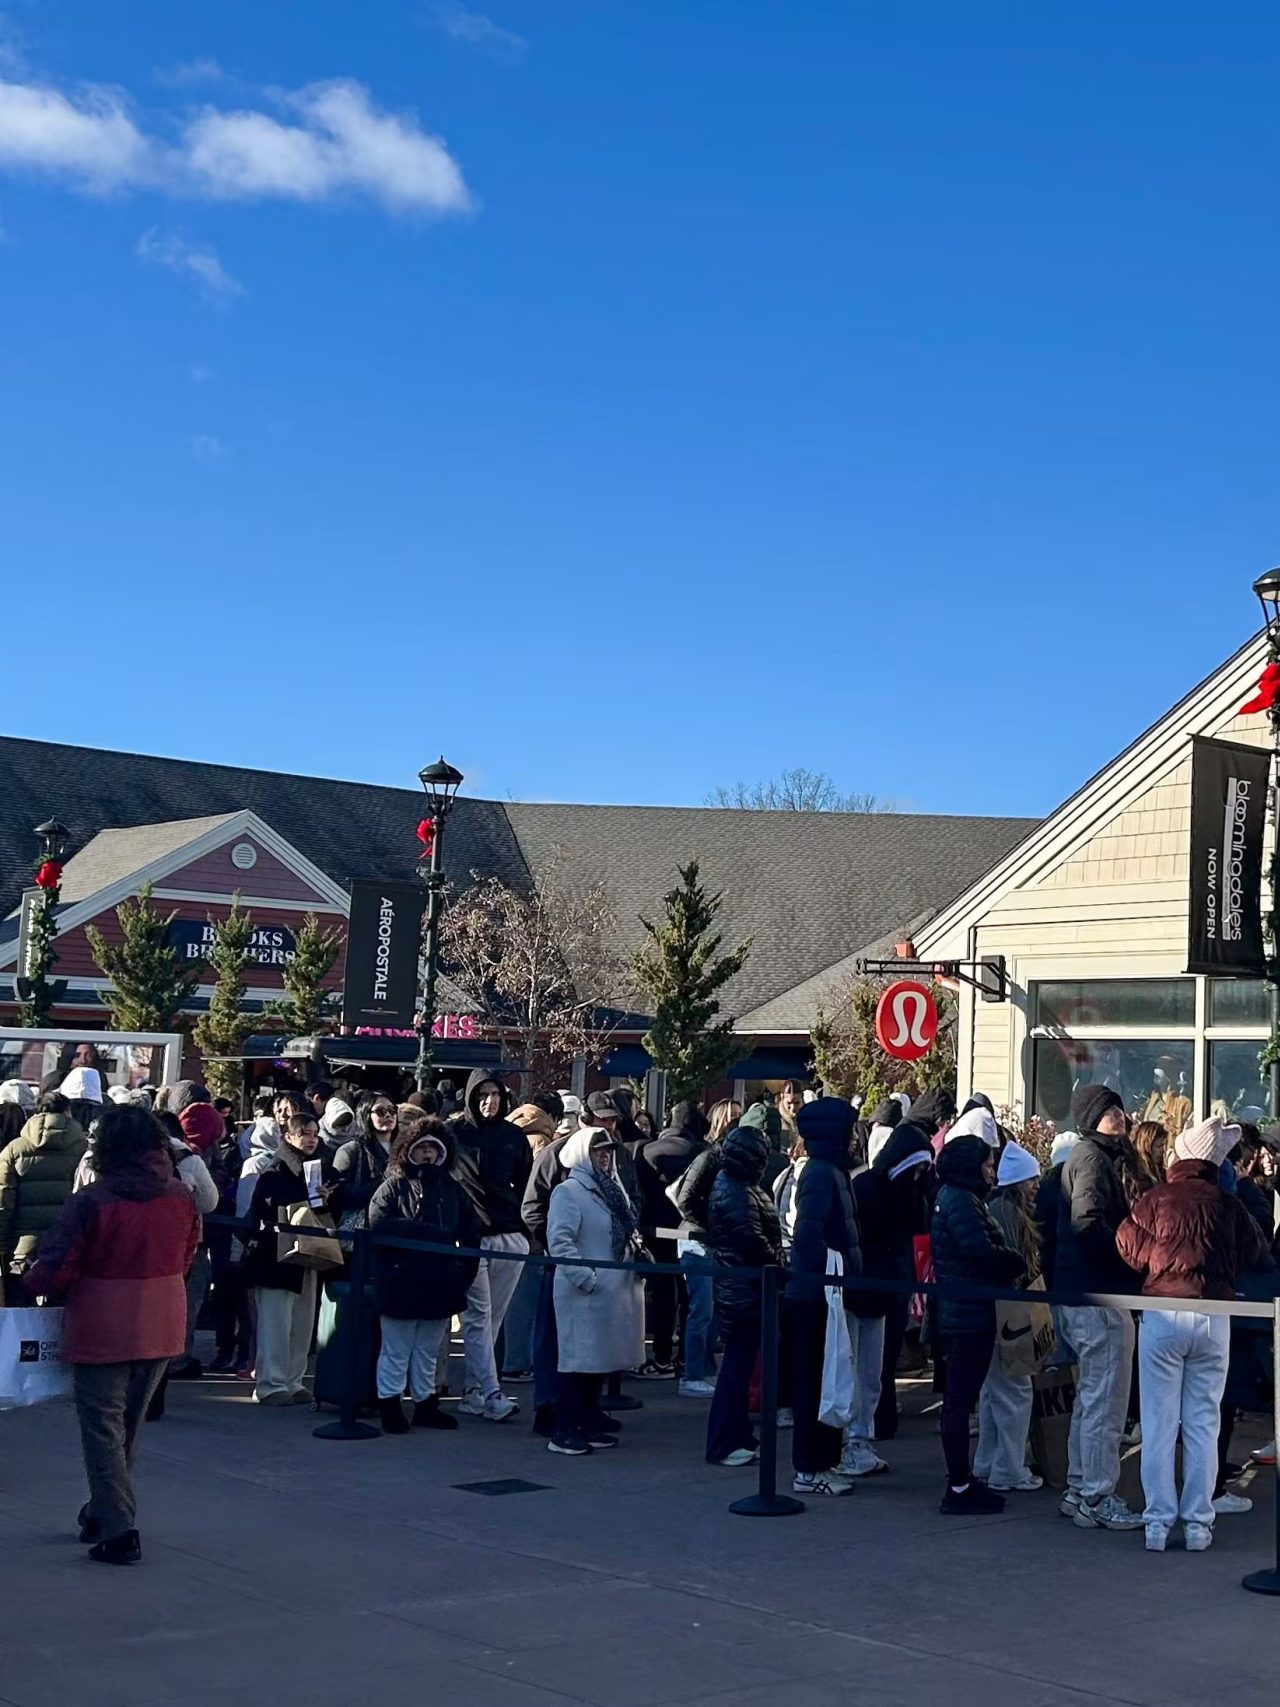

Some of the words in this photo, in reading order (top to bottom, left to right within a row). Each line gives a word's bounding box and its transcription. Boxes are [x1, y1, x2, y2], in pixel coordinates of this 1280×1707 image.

[1207, 848, 1217, 889] NOW
[1227, 780, 1251, 941] bloomingdale's
[202, 926, 283, 946] BOKS
[1206, 894, 1216, 939] OPEN
[186, 943, 296, 964] BRHERS
[374, 896, 395, 1000] AÉROPOSTALE
